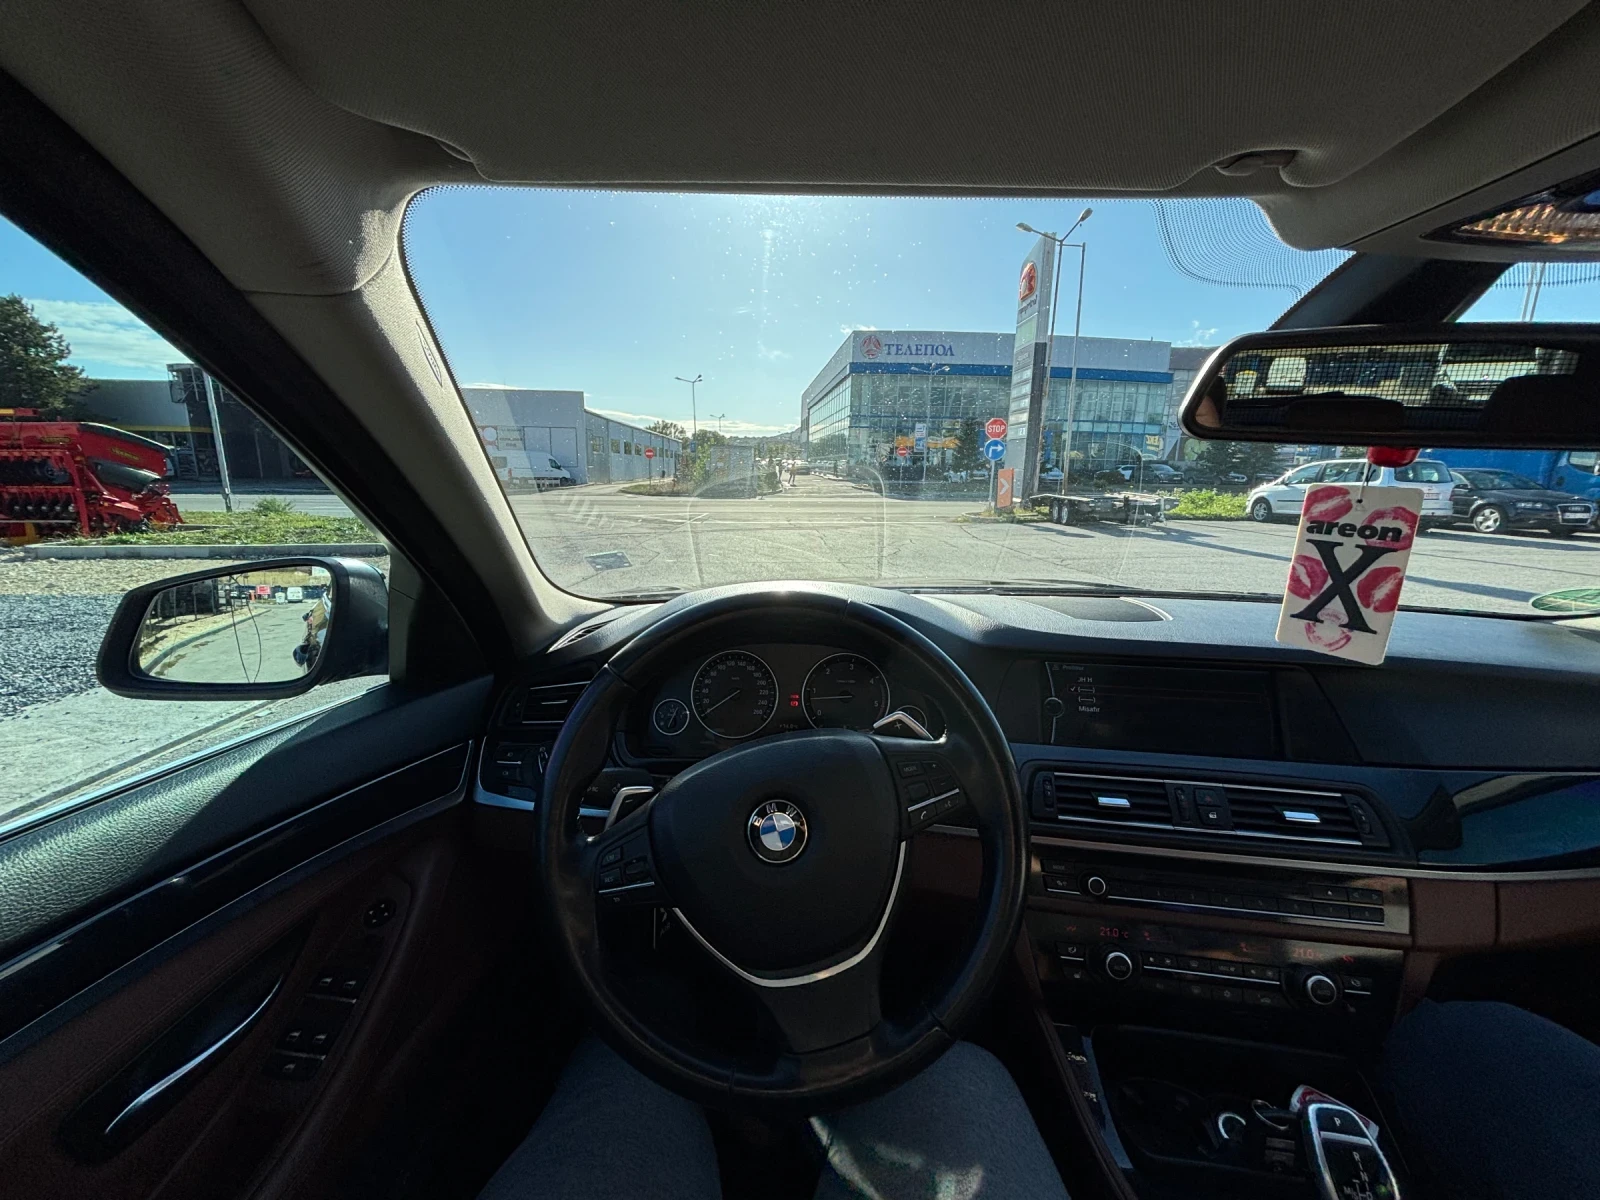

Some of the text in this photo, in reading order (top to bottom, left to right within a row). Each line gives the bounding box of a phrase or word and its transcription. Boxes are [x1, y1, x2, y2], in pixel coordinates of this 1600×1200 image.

[884, 343, 955, 356] ТЕЛЕПОЛ
[987, 424, 1006, 433] STOP
[1306, 520, 1403, 542] areon
[1290, 538, 1399, 635] X
[752, 802, 798, 827] BMW
[1100, 926, 1119, 937] 21.0
[1333, 1116, 1341, 1127] P
[1352, 1151, 1360, 1162] R
[1360, 1171, 1369, 1182] N
